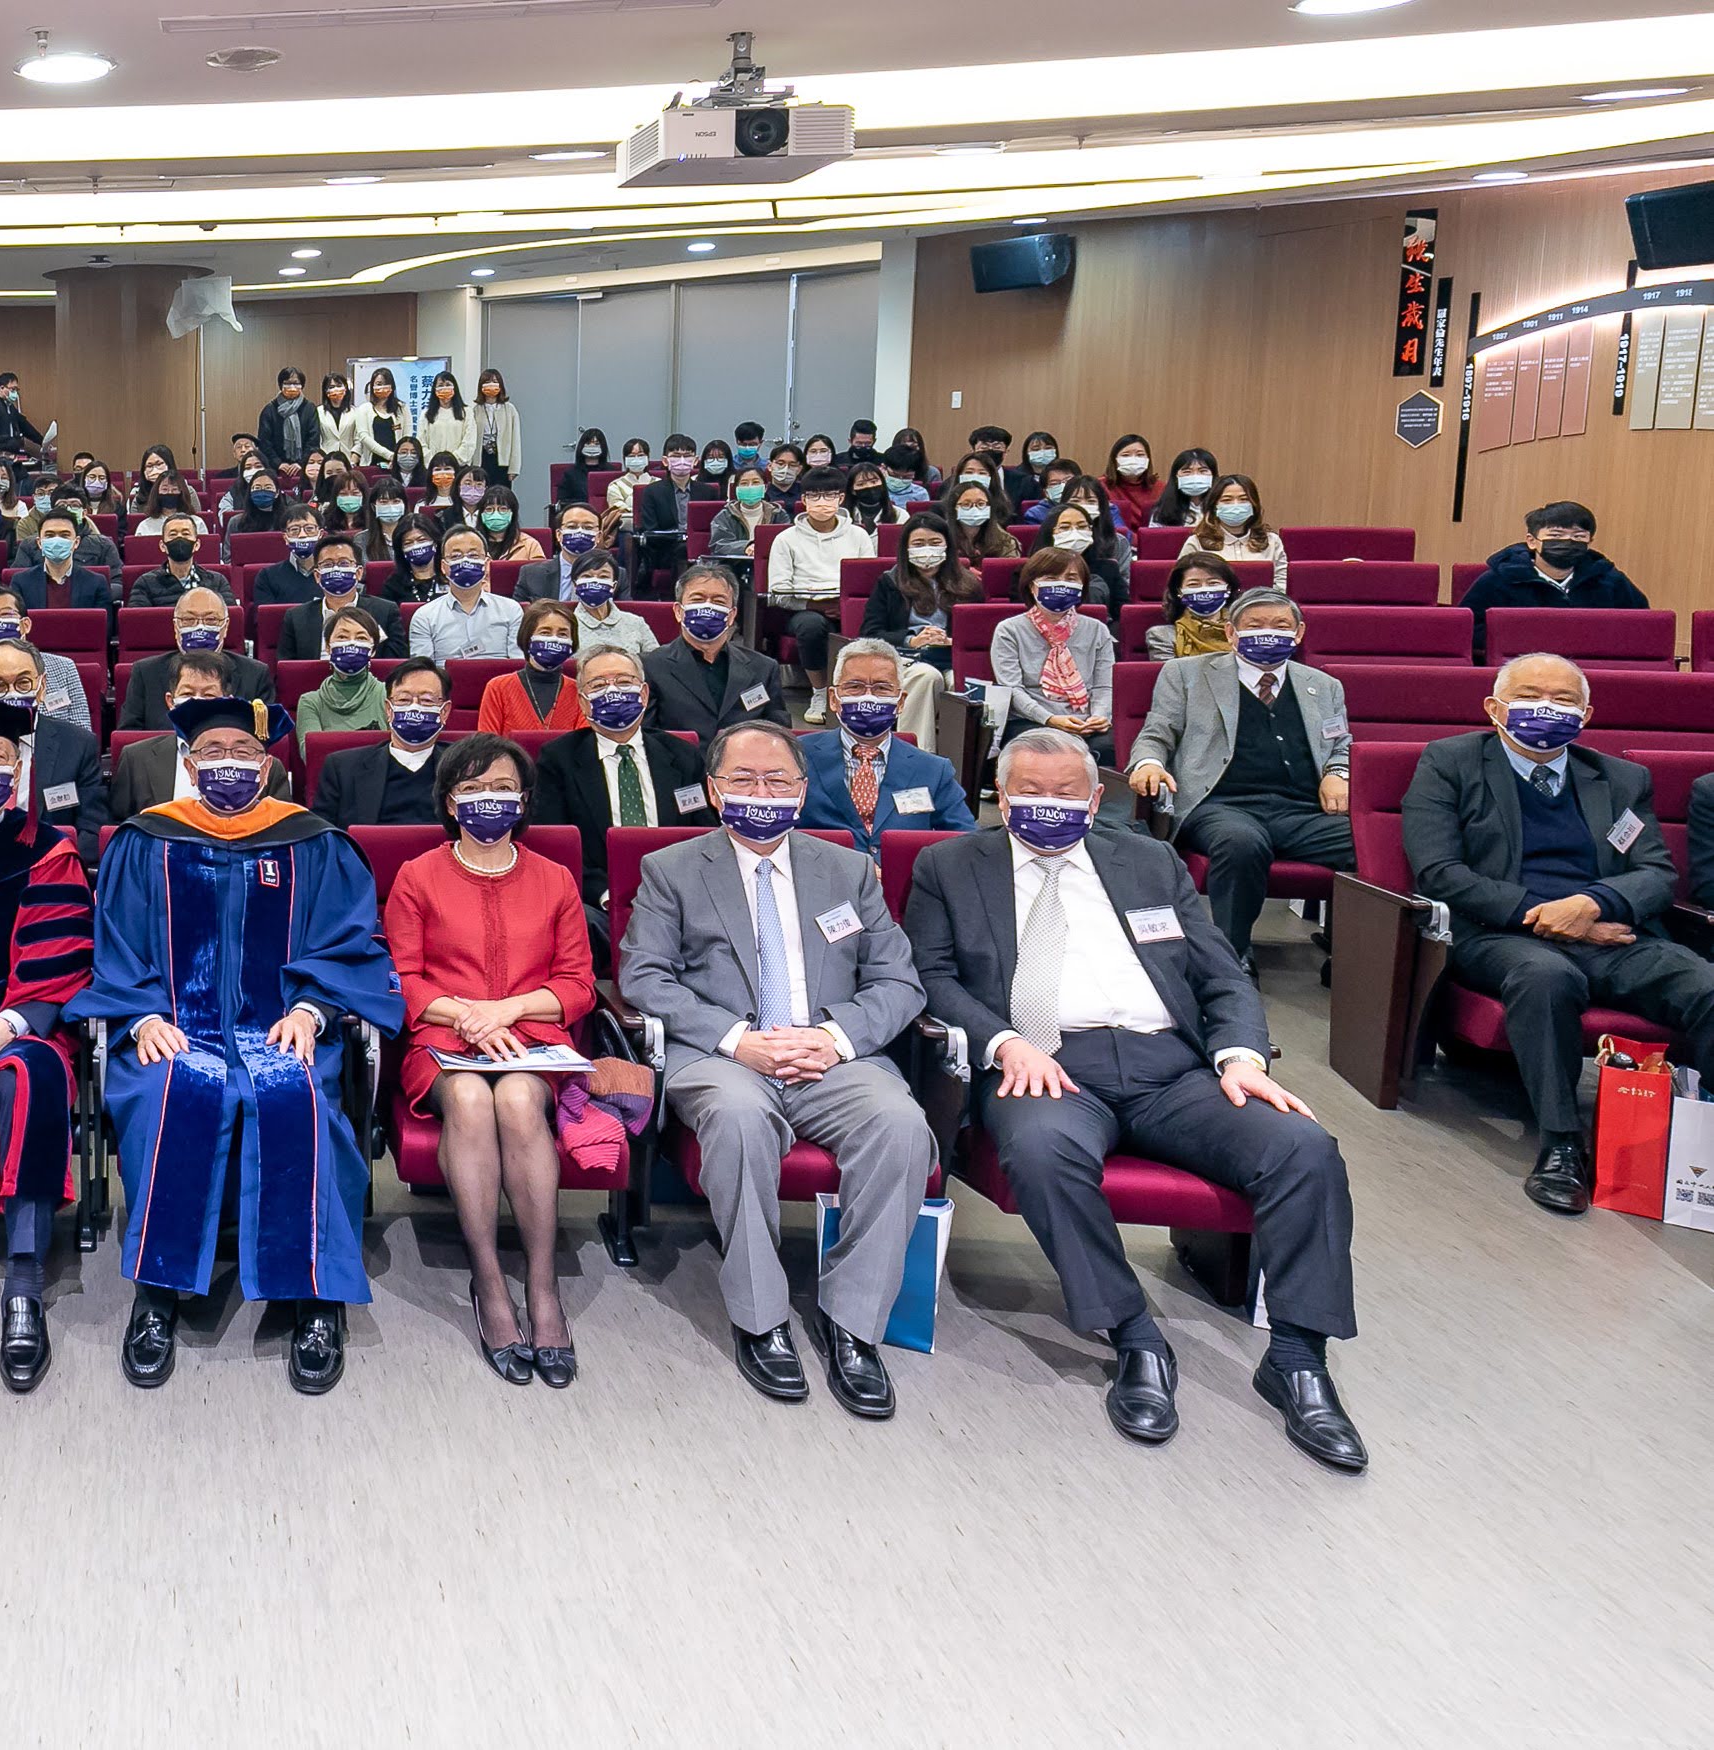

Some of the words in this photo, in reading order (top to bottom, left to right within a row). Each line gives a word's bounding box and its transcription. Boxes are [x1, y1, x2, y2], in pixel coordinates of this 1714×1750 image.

[1643, 291, 1661, 300] 1917
[1572, 306, 1589, 314] 1914
[1548, 313, 1563, 321] 1911
[827, 918, 852, 934] 陳力俊
